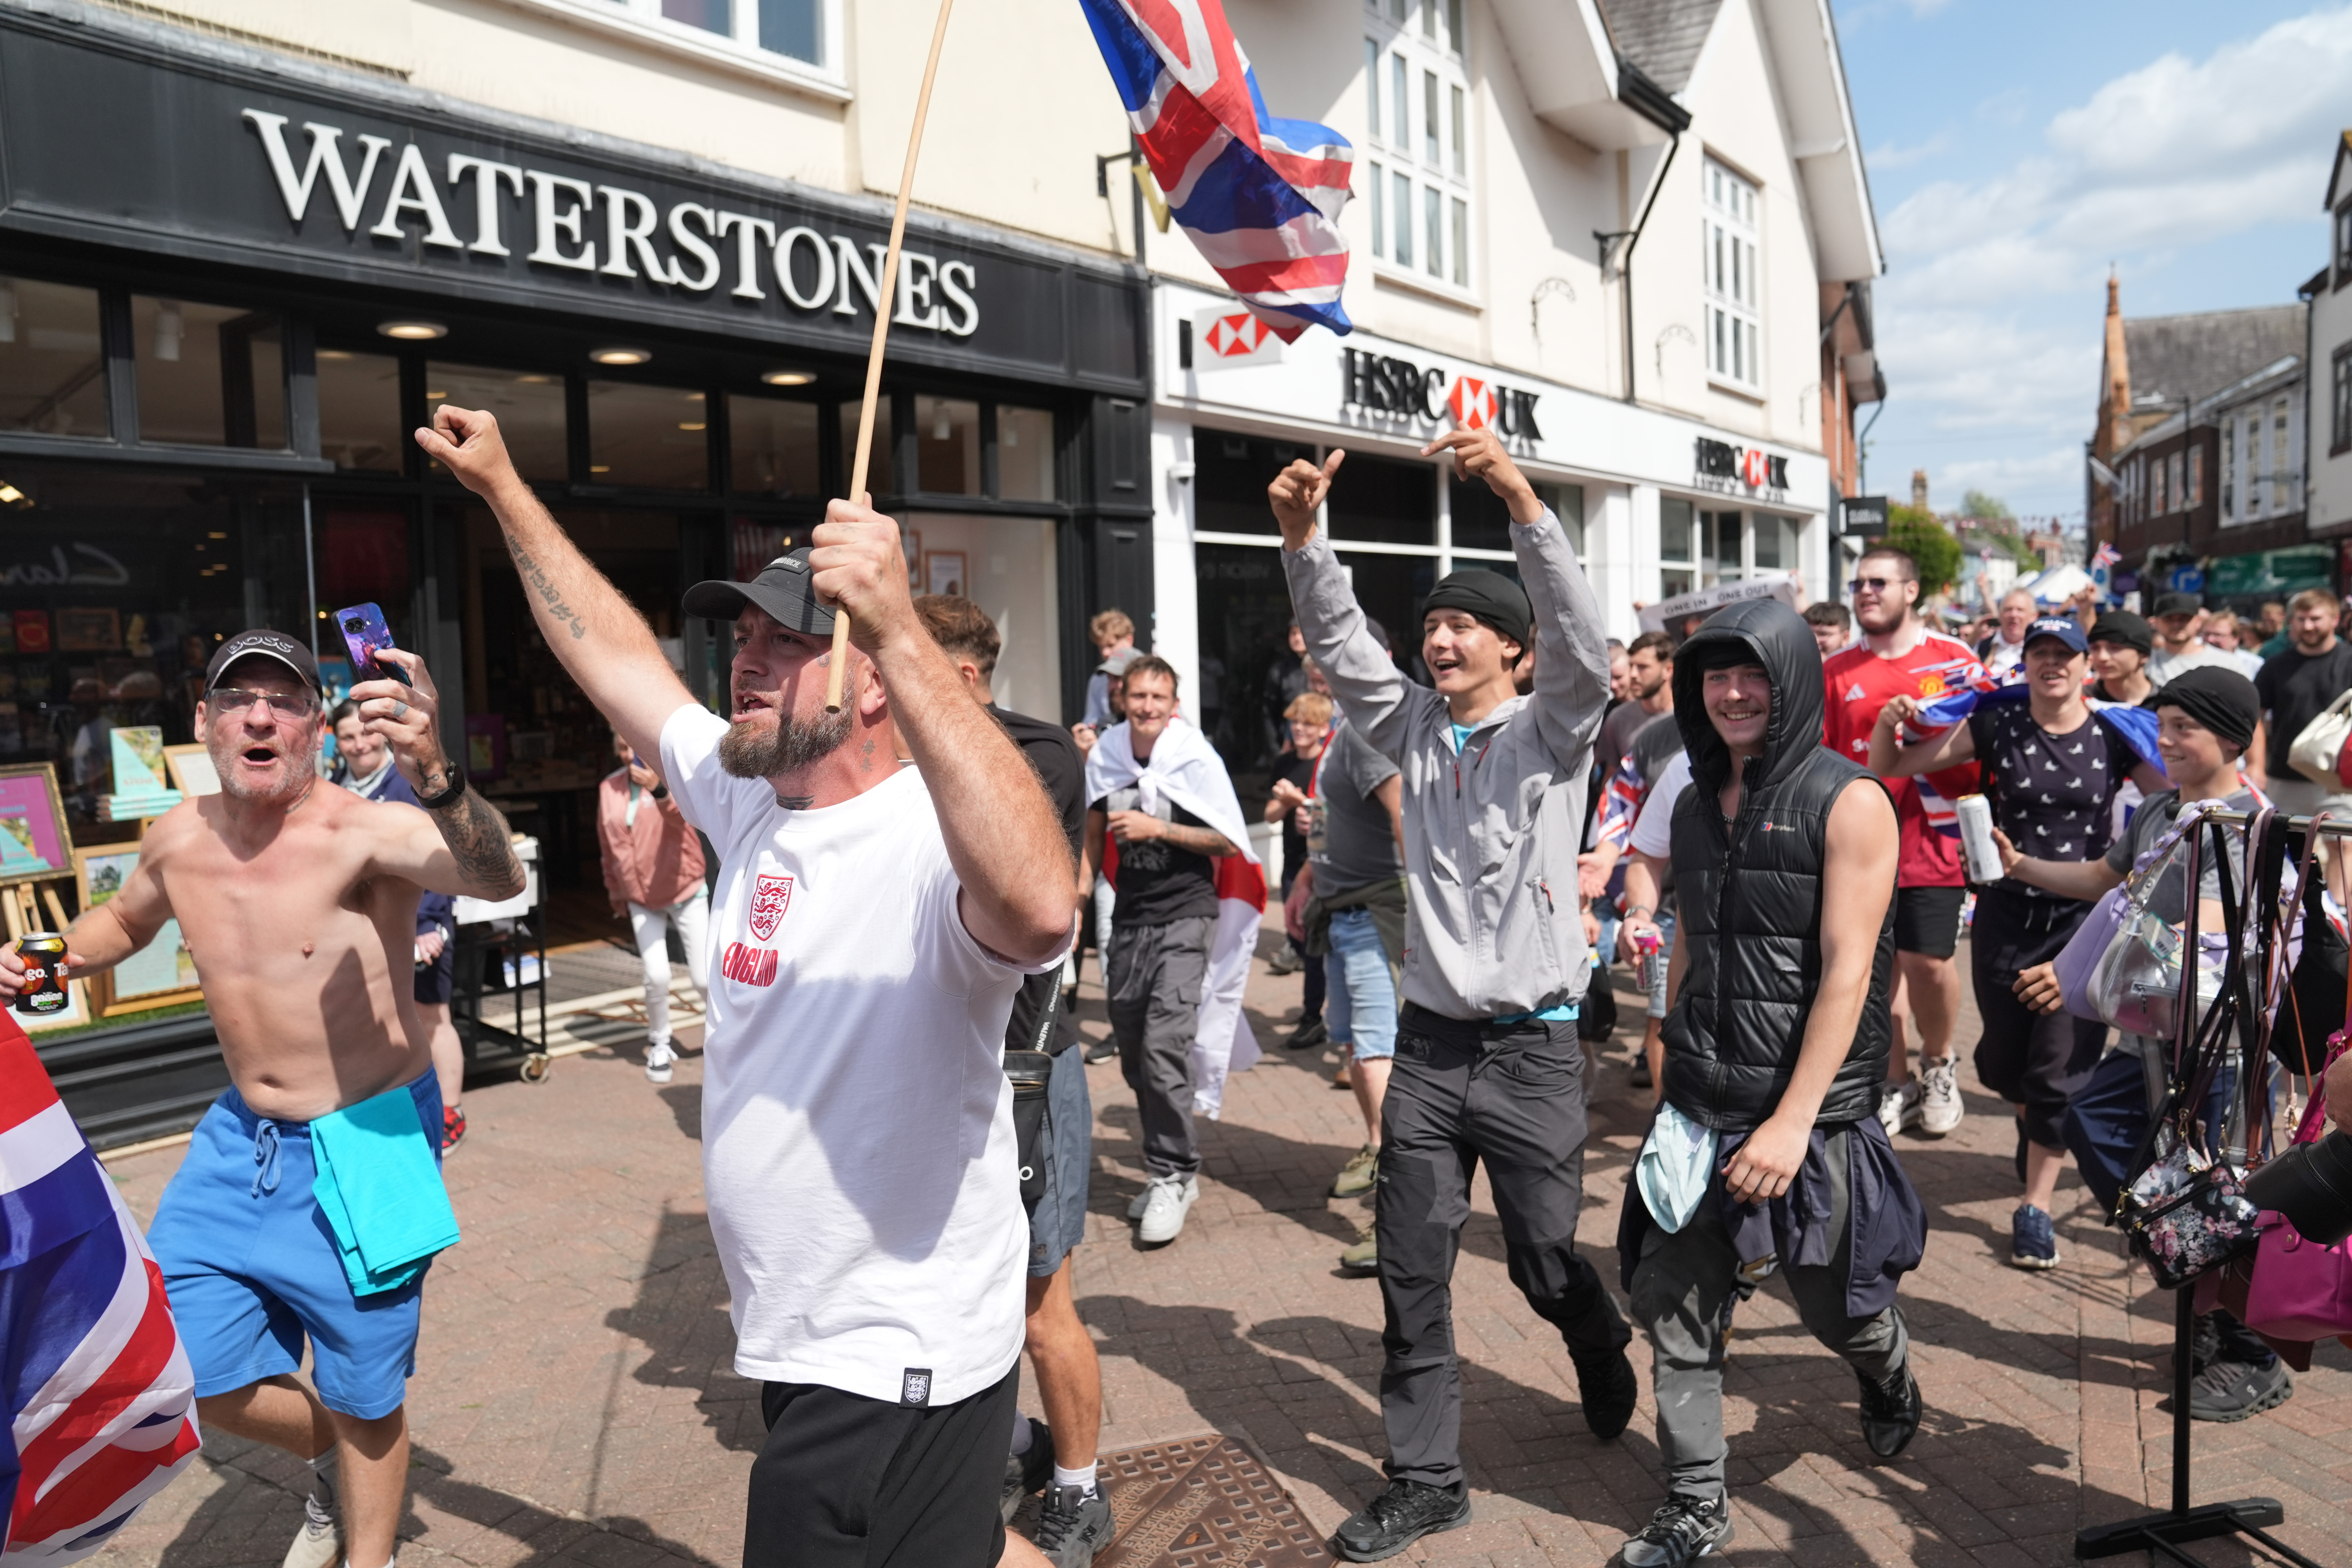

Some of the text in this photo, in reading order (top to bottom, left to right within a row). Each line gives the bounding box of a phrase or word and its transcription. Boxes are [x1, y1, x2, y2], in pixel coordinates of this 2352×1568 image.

[241, 108, 979, 336] WATERSTONES
[1342, 347, 1544, 428] HSBC UK
[1697, 437, 1743, 480] HSBC
[1664, 584, 1768, 616] ONE IN ONE OUT
[227, 636, 294, 655] BOSS
[722, 942, 779, 987] ENGLAND
[1048, 973, 1062, 1013] VALENTINO
[1122, 1509, 1168, 1547] DUCTILE
[1135, 1522, 1170, 1551] CLASS
